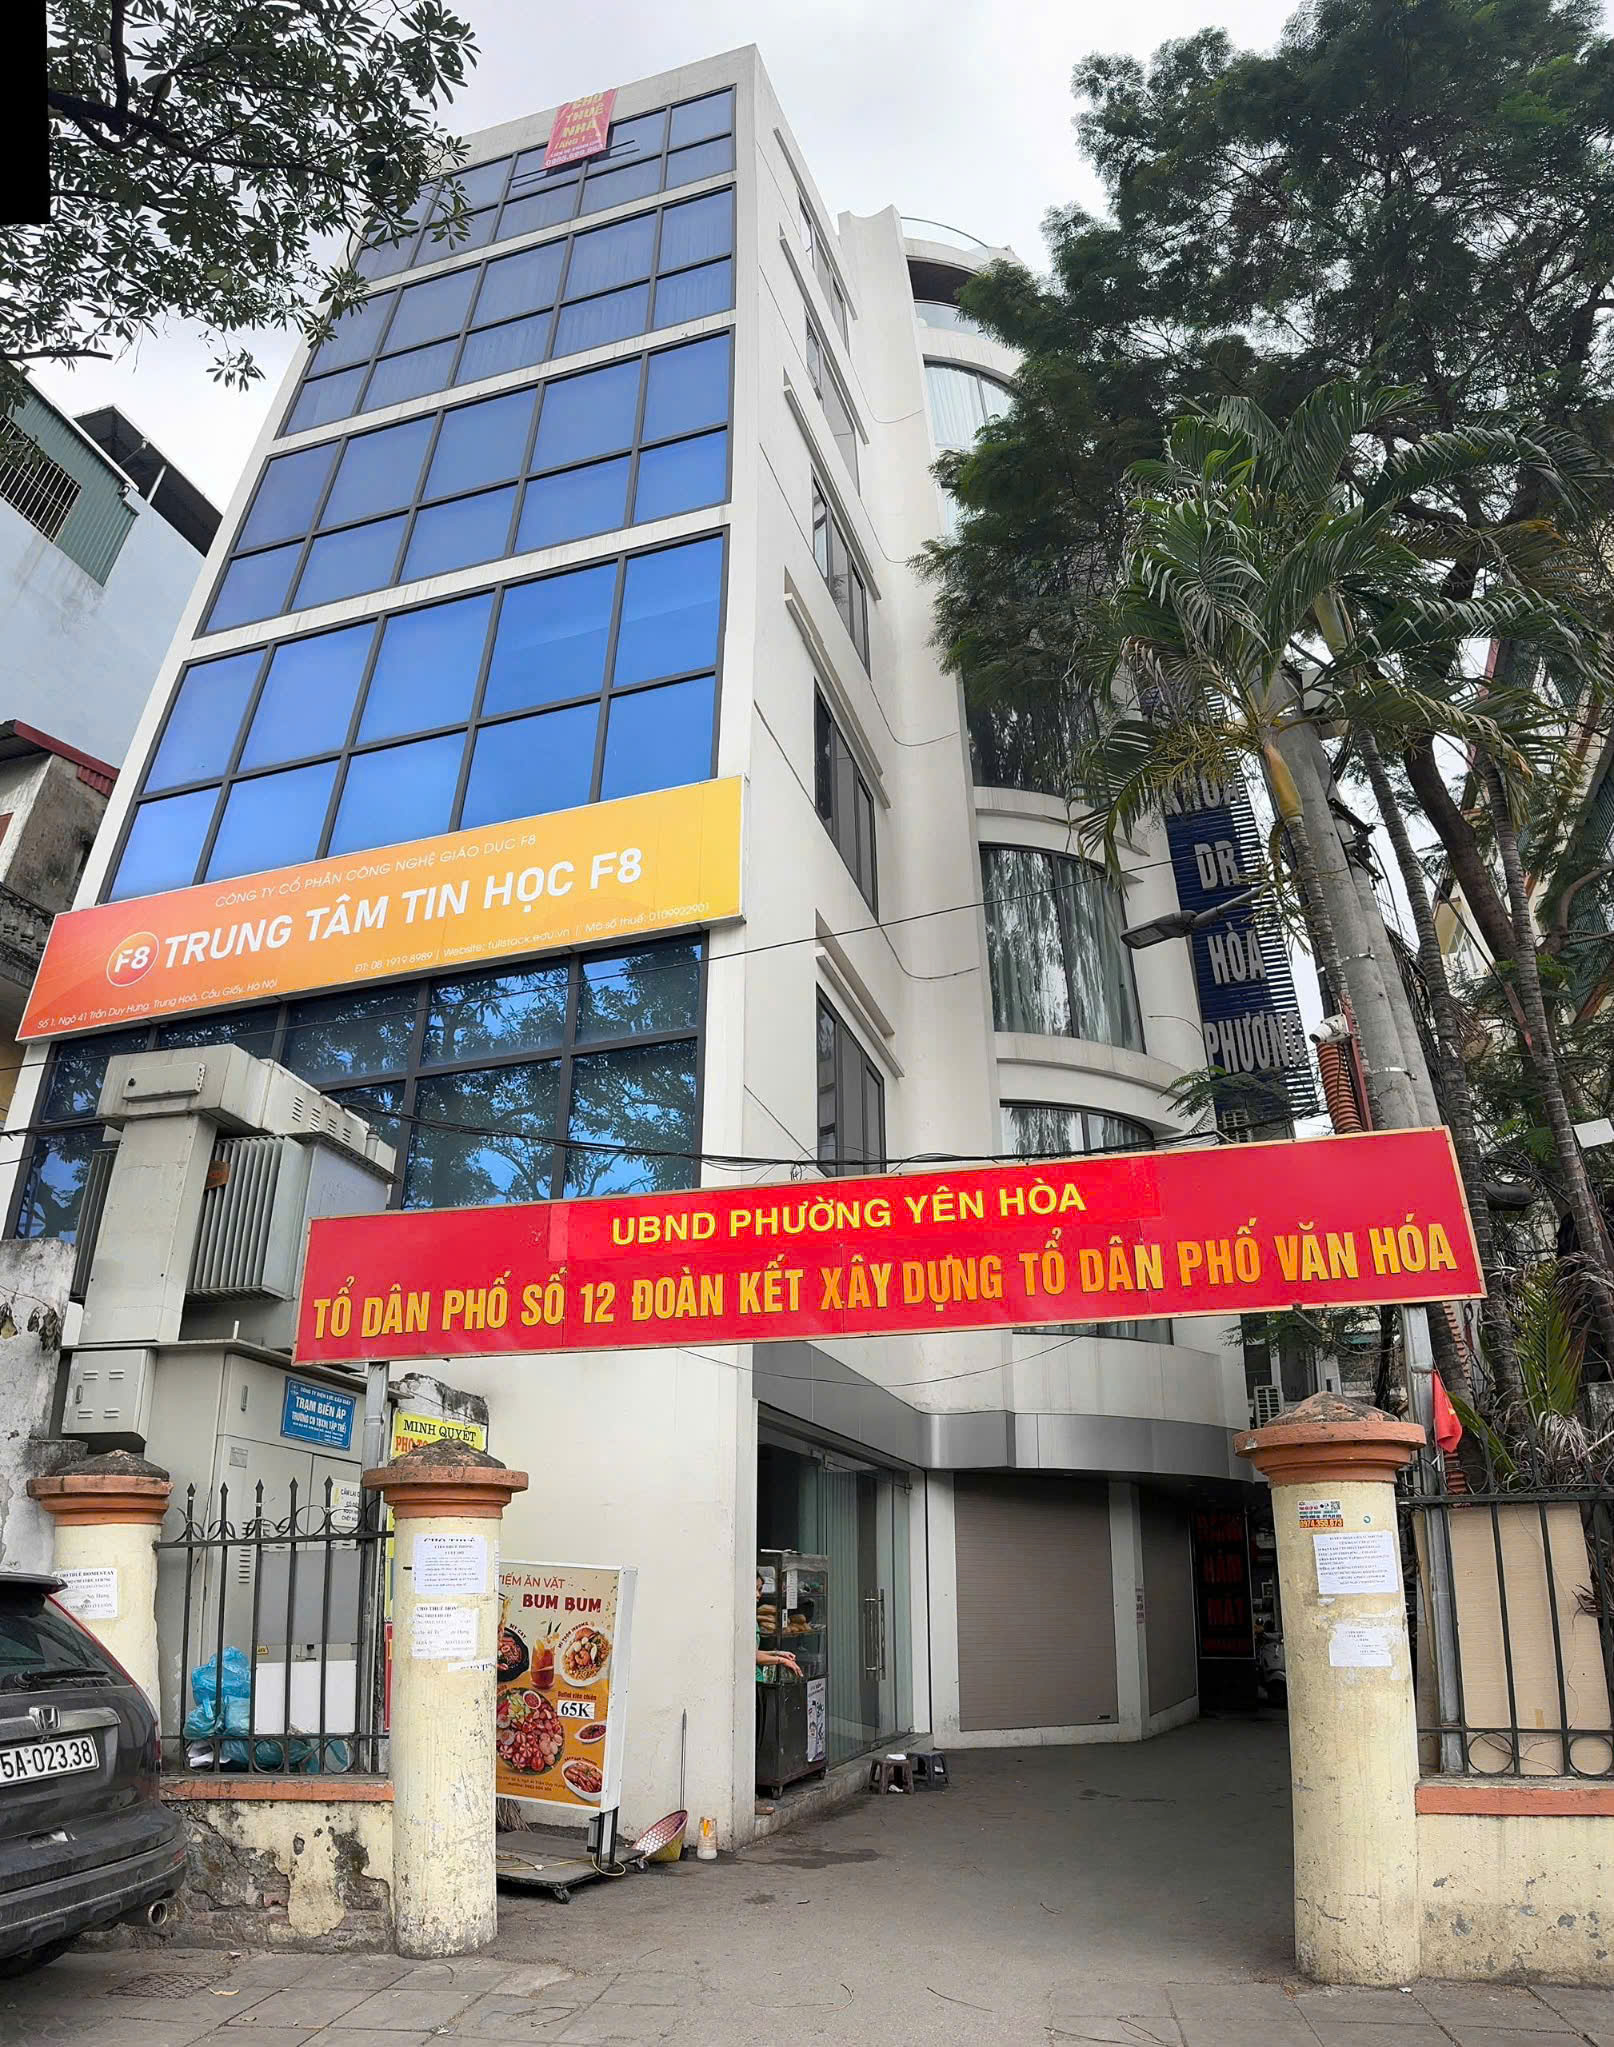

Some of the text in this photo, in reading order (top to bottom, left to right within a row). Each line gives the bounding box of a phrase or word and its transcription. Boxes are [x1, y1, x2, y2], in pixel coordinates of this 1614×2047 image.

[215, 833, 537, 908] CÔNG TY CỔ PHẦN CÔNG NGHỆ GIÁO DỤC F8
[1194, 840, 1239, 889] DR
[164, 847, 643, 969] TRUNG TÂM TIN HỌC F8
[113, 946, 151, 974] F8
[443, 941, 487, 959] Website:
[488, 927, 571, 951] fullstack.edu.vn
[1207, 921, 1267, 985] HÒA
[108, 1004, 126, 1018] Duy
[1204, 1009, 1304, 1075] PHƯƠNG
[611, 1177, 1087, 1246] UBND PHƯỜNG YÊN HÒA
[313, 1213, 1458, 1340] TỔ DÂN PHỐ SỐ 12 ĐOÀN KẾT XÂY DỰNG TỔ DÂN PHỐ VĂN HÓA
[296, 1396, 347, 1420] TRẠM BIẾN ÁP
[403, 1419, 477, 1442] MINH QUYẾT
[523, 1574, 541, 1588] ĂN
[543, 1576, 567, 1591] VẶT
[522, 1593, 602, 1613] BUM BUM
[560, 1701, 591, 1718] 65K
[0, 1740, 93, 1778] 5A-023.38
